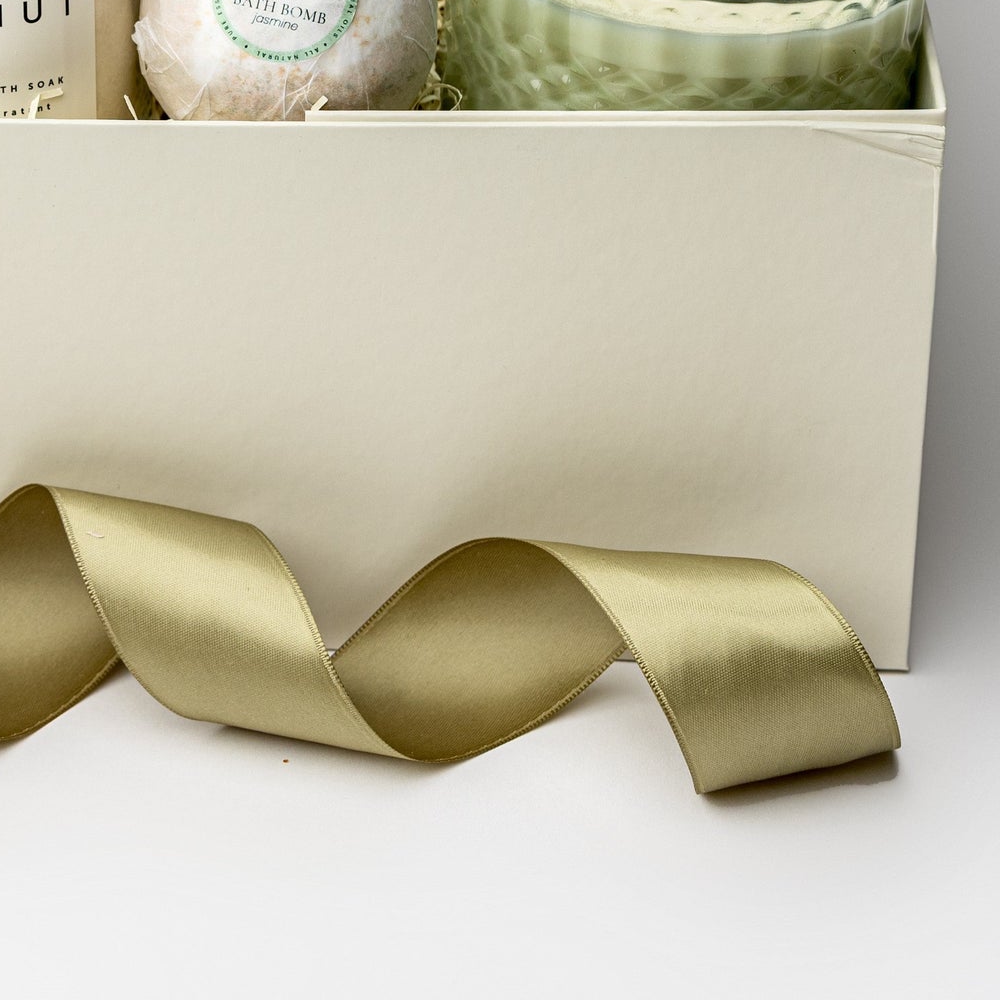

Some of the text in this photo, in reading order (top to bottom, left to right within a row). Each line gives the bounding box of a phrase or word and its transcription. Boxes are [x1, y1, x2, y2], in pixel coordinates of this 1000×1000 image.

[251, 13, 299, 31] jasmine
[281, 3, 326, 25] BOMB
[28, 76, 64, 91] SOAK
